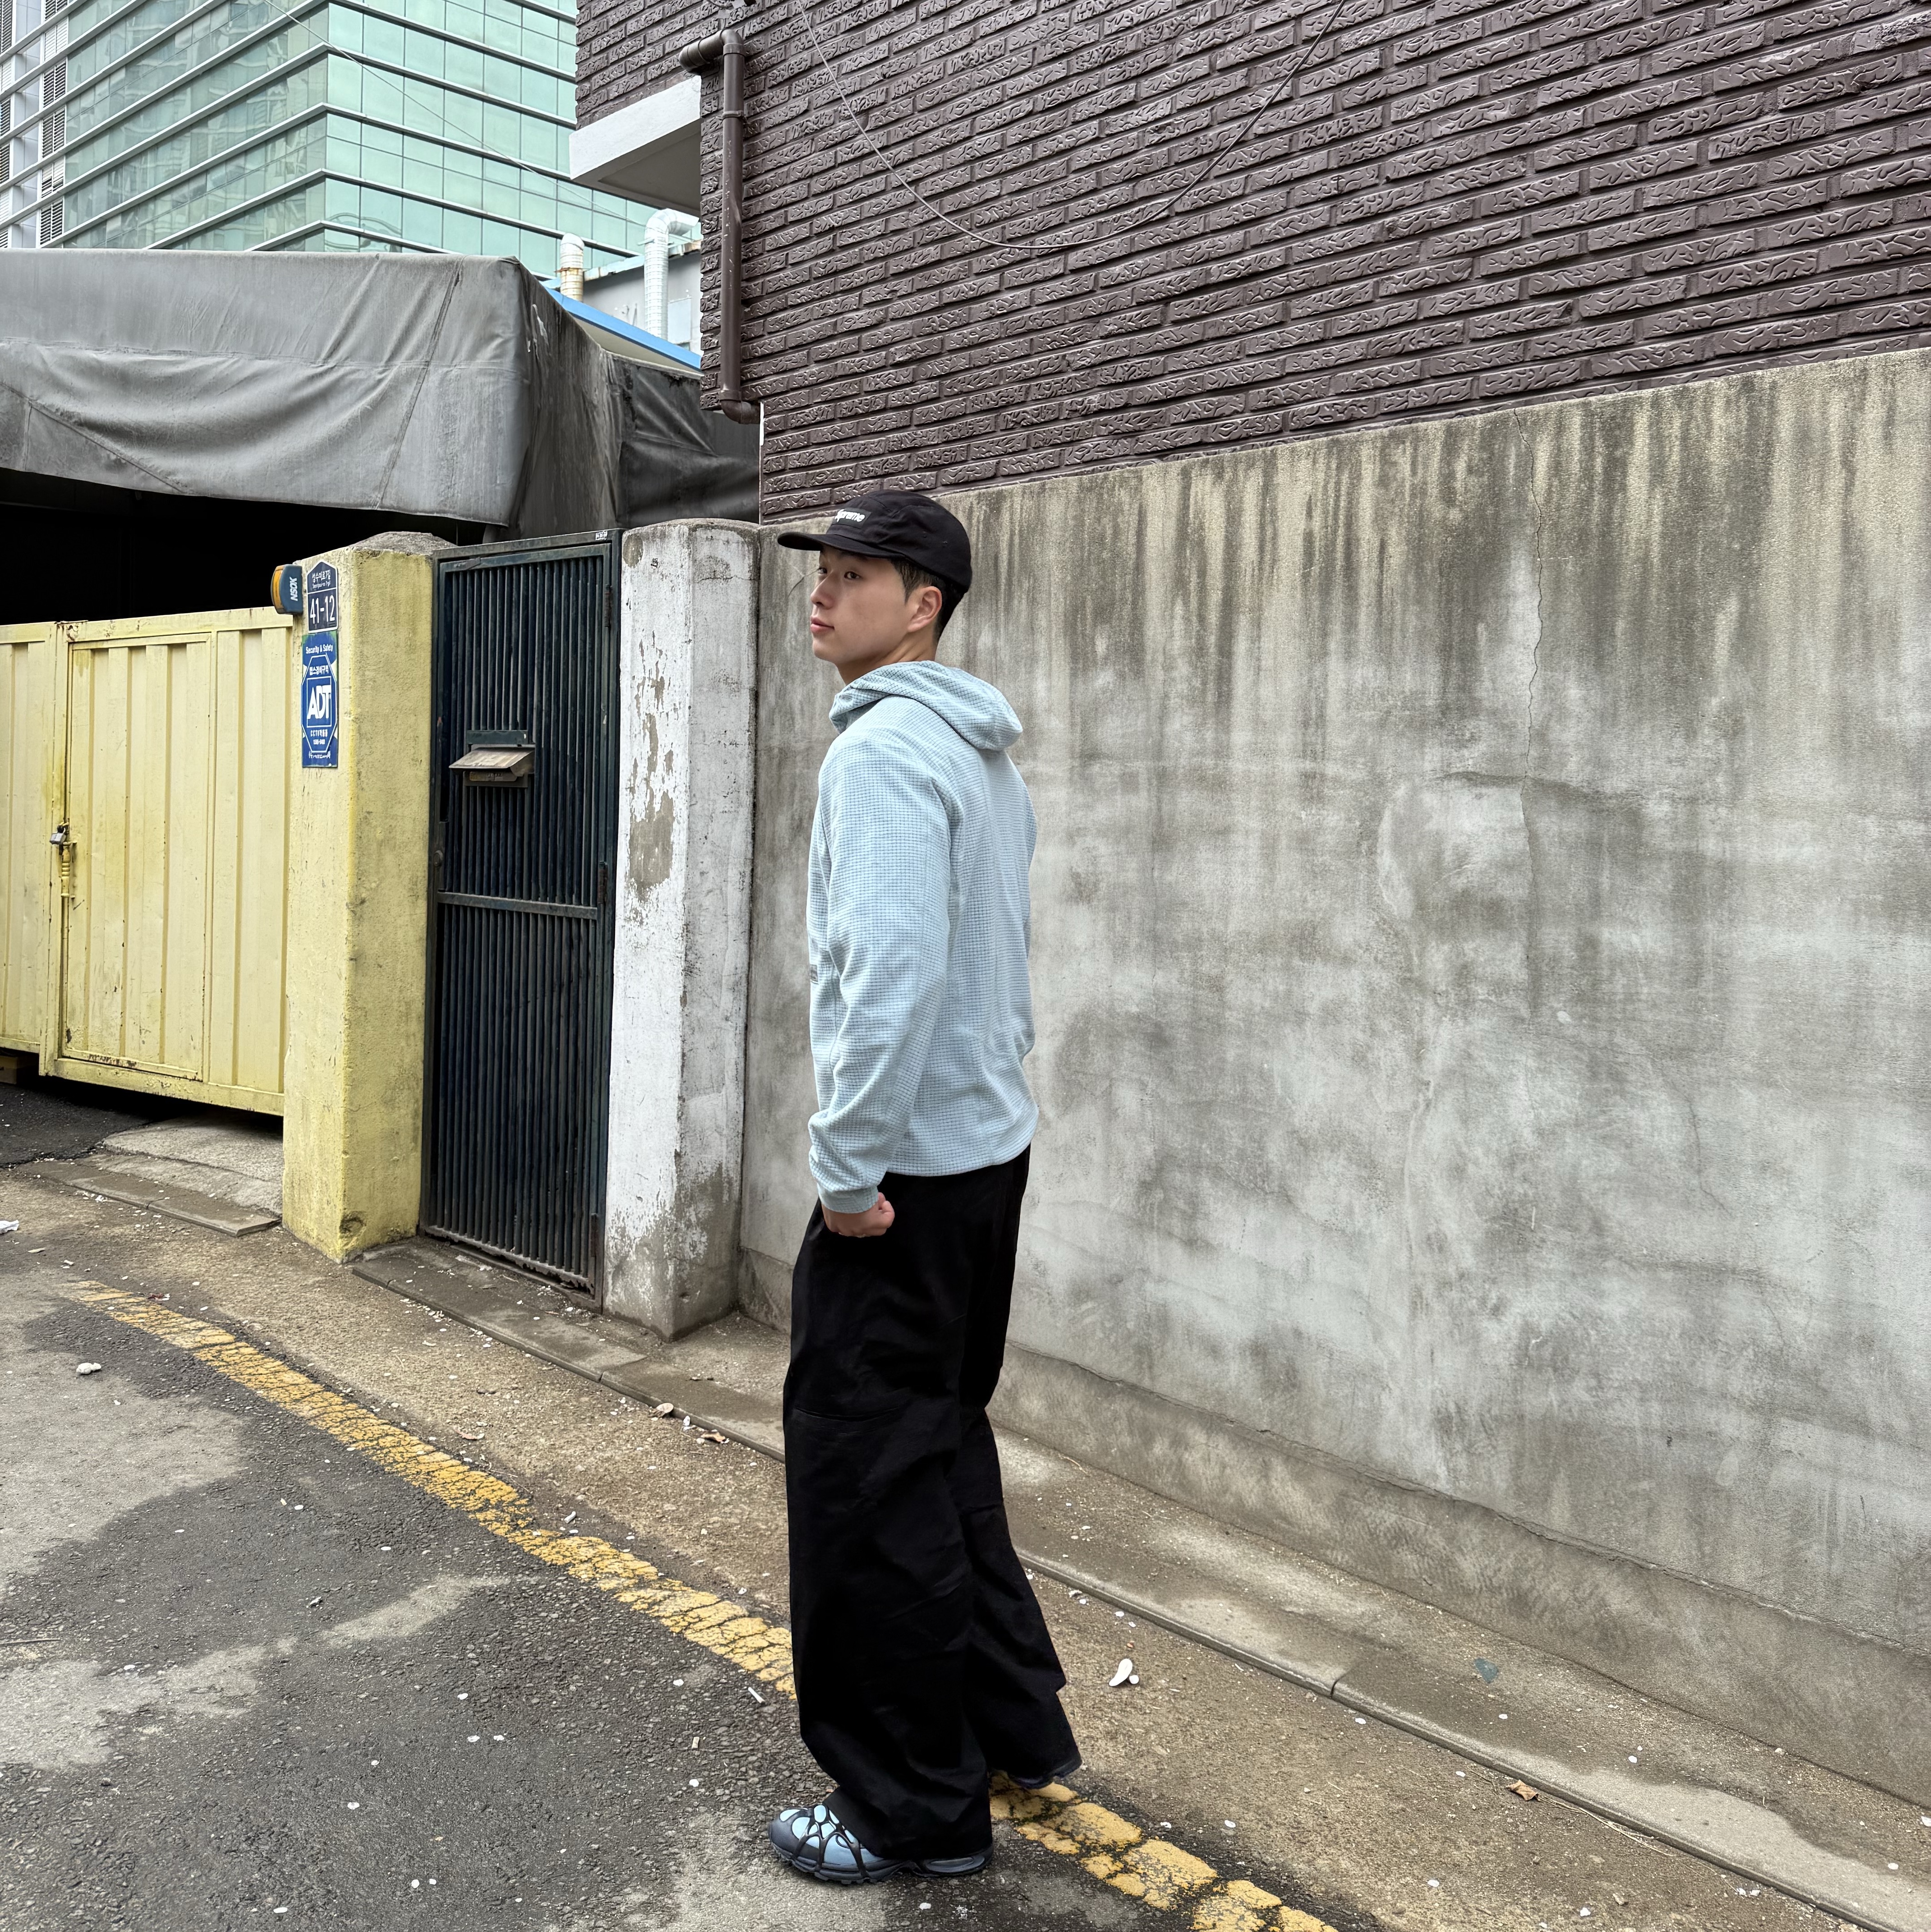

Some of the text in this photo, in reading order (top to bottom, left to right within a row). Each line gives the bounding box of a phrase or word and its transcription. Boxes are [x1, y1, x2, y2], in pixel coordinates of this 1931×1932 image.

[289, 577, 298, 601] NSOK
[310, 595, 335, 624] 41-12
[306, 646, 319, 654] Security
[323, 644, 333, 652] Safety
[307, 684, 332, 720] ADT
